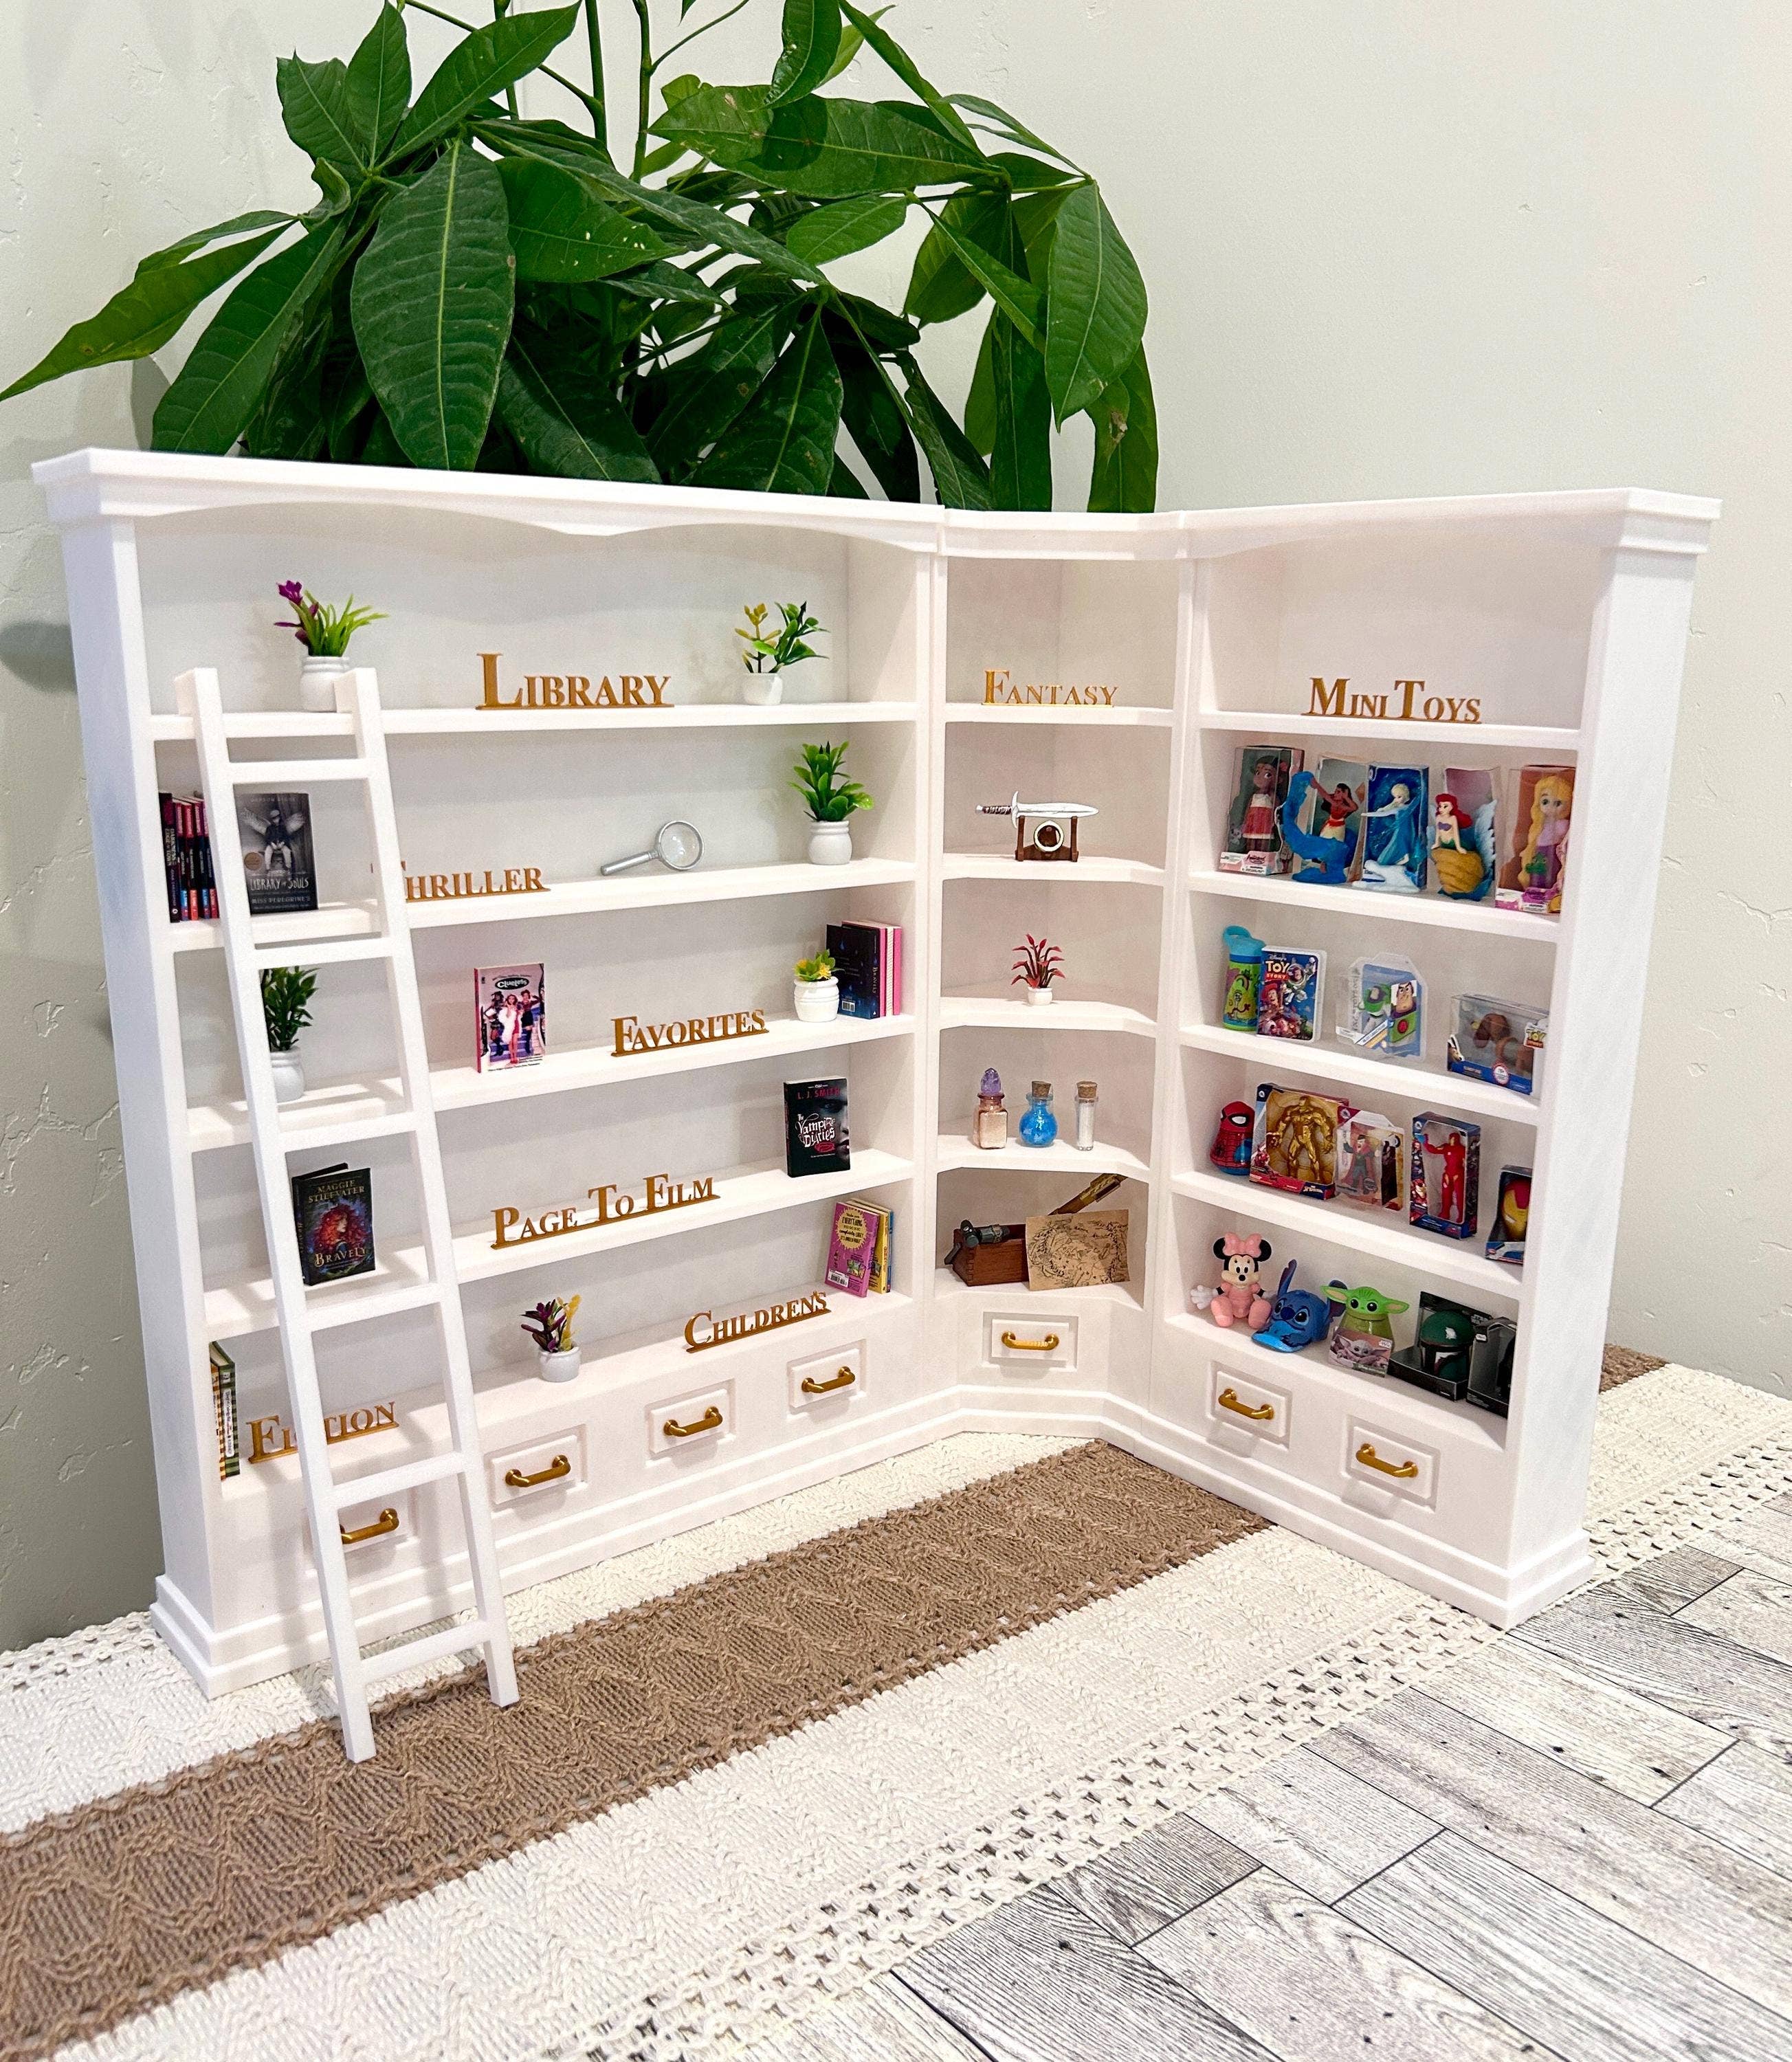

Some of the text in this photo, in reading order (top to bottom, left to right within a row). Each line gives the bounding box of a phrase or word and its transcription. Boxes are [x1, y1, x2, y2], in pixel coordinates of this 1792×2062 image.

[476, 653, 672, 707] LIBRARY
[984, 670, 1118, 705] FANTASY
[250, 879, 281, 891] LIBRARY
[401, 861, 545, 900] HRILLER
[1265, 960, 1290, 973] TOY
[611, 1009, 765, 1053] FAVORITES
[318, 1180, 355, 1193] MAGGIE
[491, 1173, 714, 1245] PAGE TO FILM
[314, 1247, 366, 1267] BRAVELY
[246, 1401, 395, 1459] FITION
